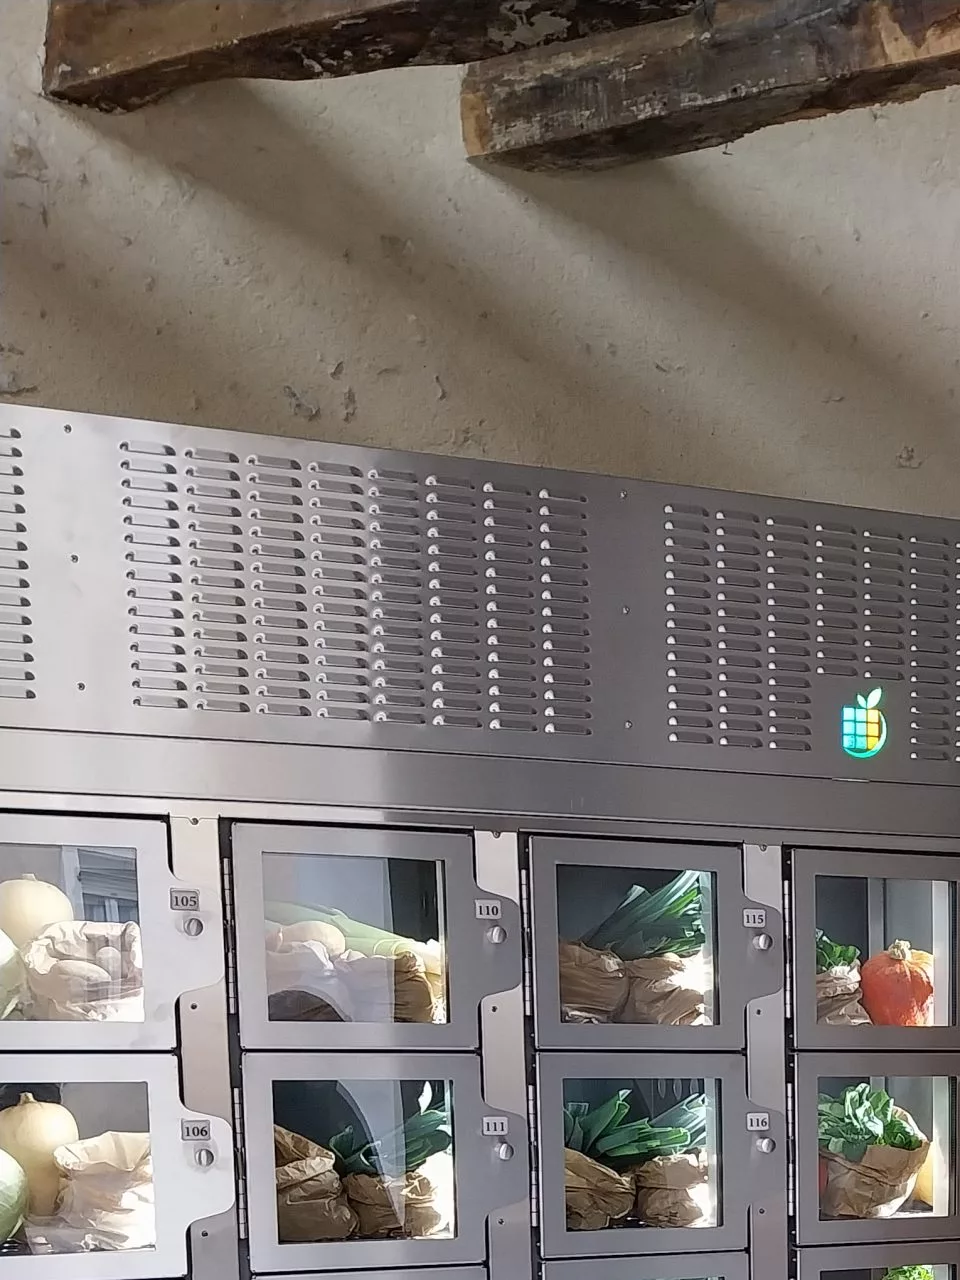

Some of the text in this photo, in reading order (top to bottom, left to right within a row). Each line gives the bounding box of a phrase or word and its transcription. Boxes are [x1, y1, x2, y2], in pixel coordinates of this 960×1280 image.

[173, 895, 197, 907] 105
[478, 904, 499, 916] 110
[745, 913, 764, 924] 115
[485, 1121, 505, 1132] 111
[749, 1117, 768, 1128] 116
[184, 1125, 208, 1137] 106
